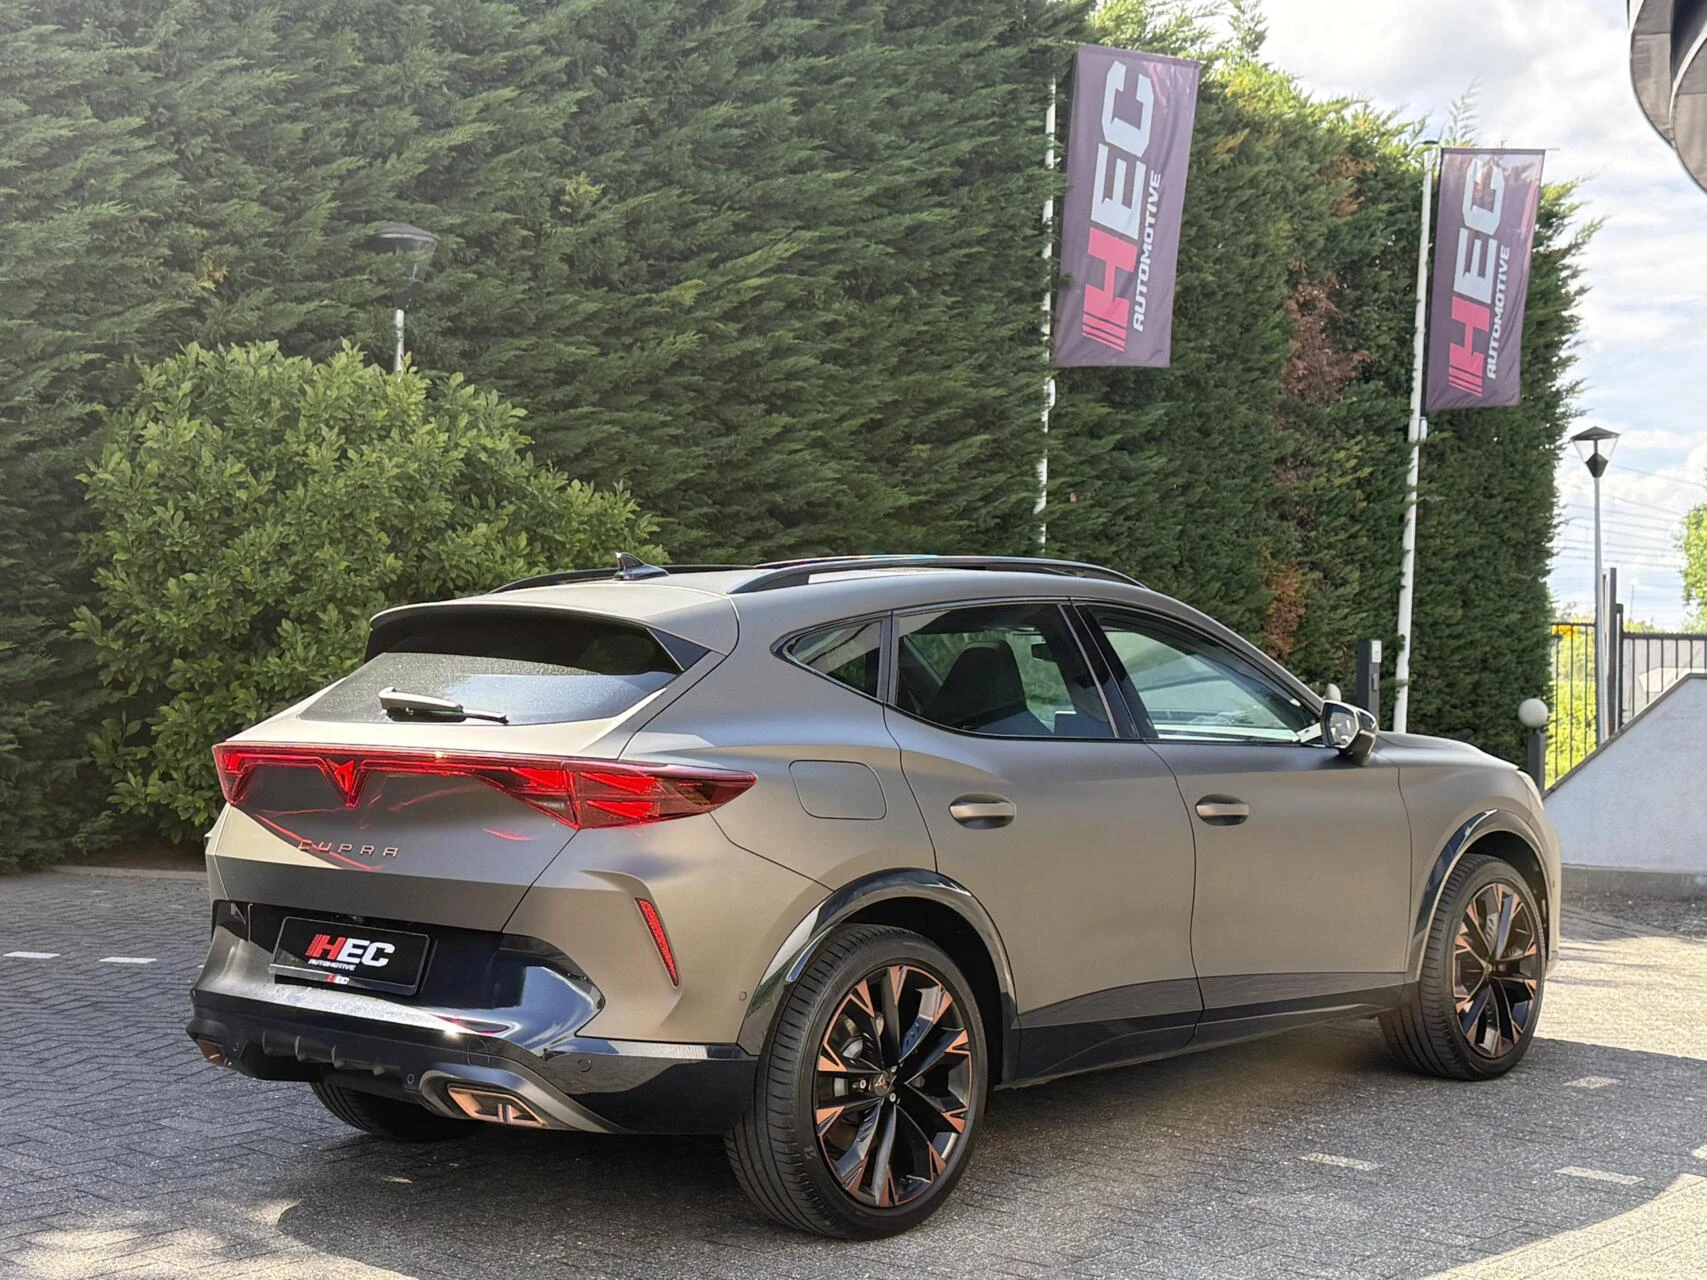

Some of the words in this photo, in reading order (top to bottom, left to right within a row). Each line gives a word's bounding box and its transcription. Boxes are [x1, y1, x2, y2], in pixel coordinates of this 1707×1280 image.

[1082, 60, 1154, 352] HEC
[1133, 170, 1162, 332] AUTOMOTIVE
[1448, 157, 1505, 397] HEC
[1487, 245, 1510, 379] AUTOMOTIVE
[298, 839, 399, 857] CUPRA
[305, 933, 396, 968] HEC
[308, 958, 357, 972] AUTOMOTIVE
